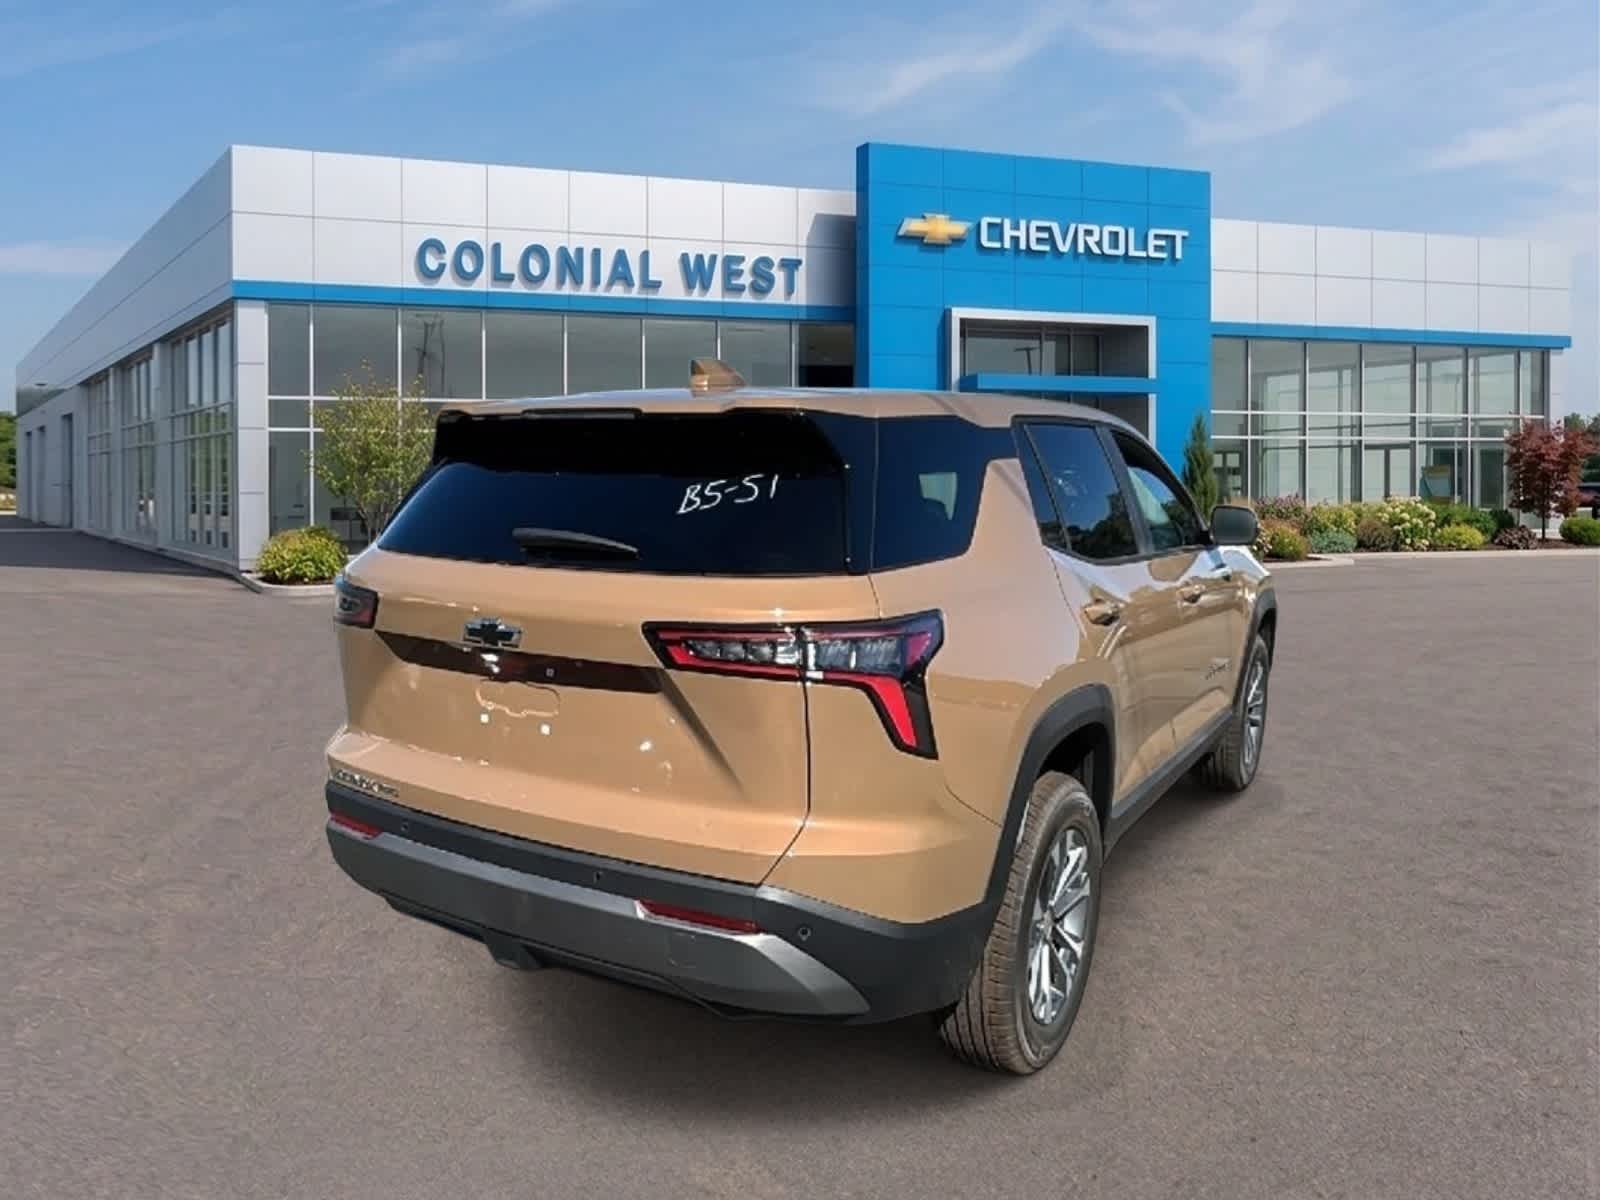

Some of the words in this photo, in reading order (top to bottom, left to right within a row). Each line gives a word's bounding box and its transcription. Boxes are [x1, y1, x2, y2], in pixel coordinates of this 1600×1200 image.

[979, 215, 1190, 261] CHEVROLET
[416, 238, 662, 289] COLONIAL
[680, 251, 803, 296] WEST
